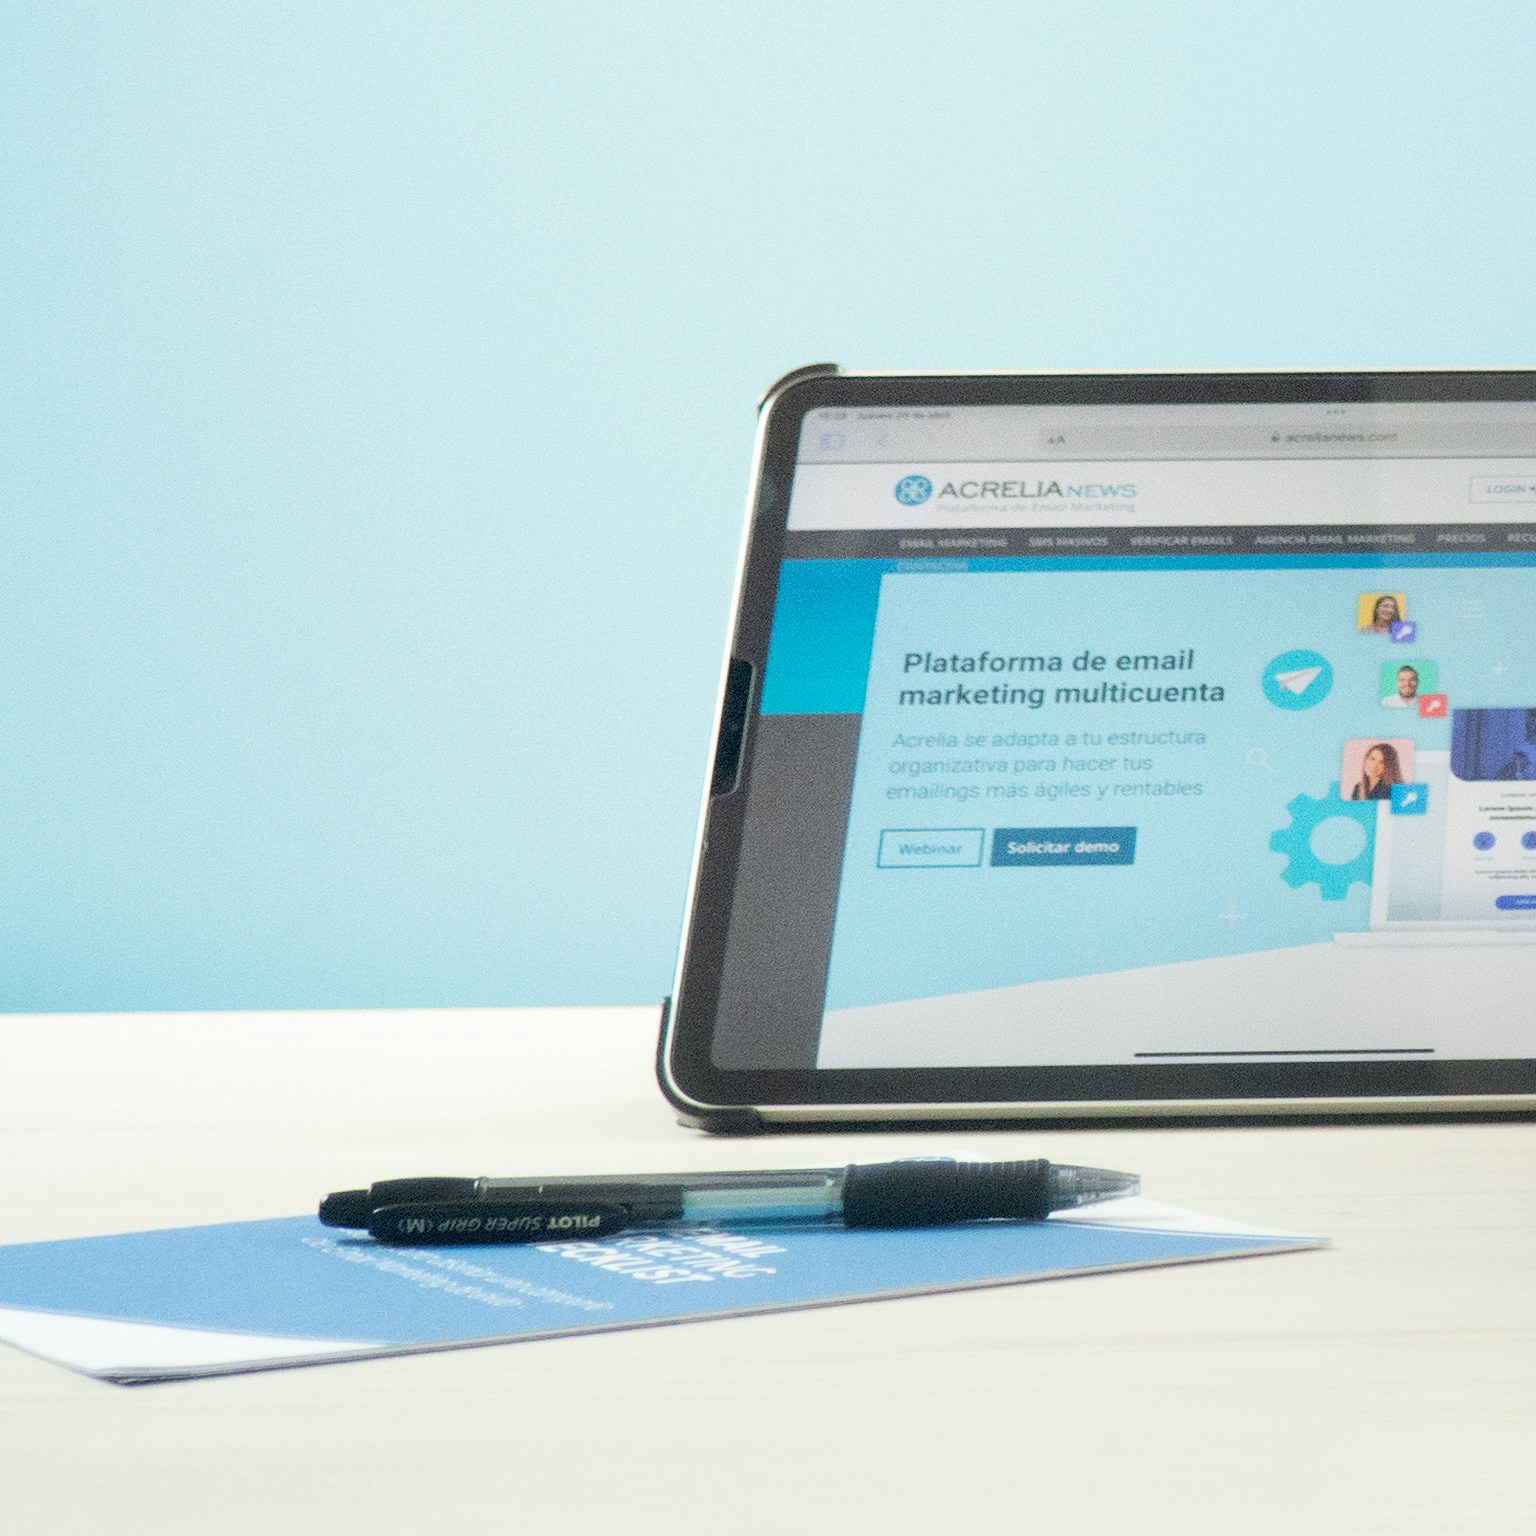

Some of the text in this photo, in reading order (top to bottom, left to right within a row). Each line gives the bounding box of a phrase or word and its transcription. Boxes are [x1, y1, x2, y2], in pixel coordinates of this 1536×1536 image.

[1486, 484, 1527, 495] LOGIN
[902, 648, 1195, 674] Plataforma de email
[898, 681, 1226, 710] marketing multicuenta
[892, 729, 1206, 751] Acrelia se adapta a tu estructura
[888, 755, 1153, 778] organizativa para hacer tus
[885, 780, 1204, 803] emailings más ágiles y rentables
[898, 843, 963, 856] Webinar
[1006, 839, 1120, 855] Solicitar demo
[437, 1217, 481, 1233] GRIP
[485, 1216, 543, 1232] SUPER
[547, 1215, 601, 1230] PILOT
[535, 1242, 716, 1285] ECKLIST
